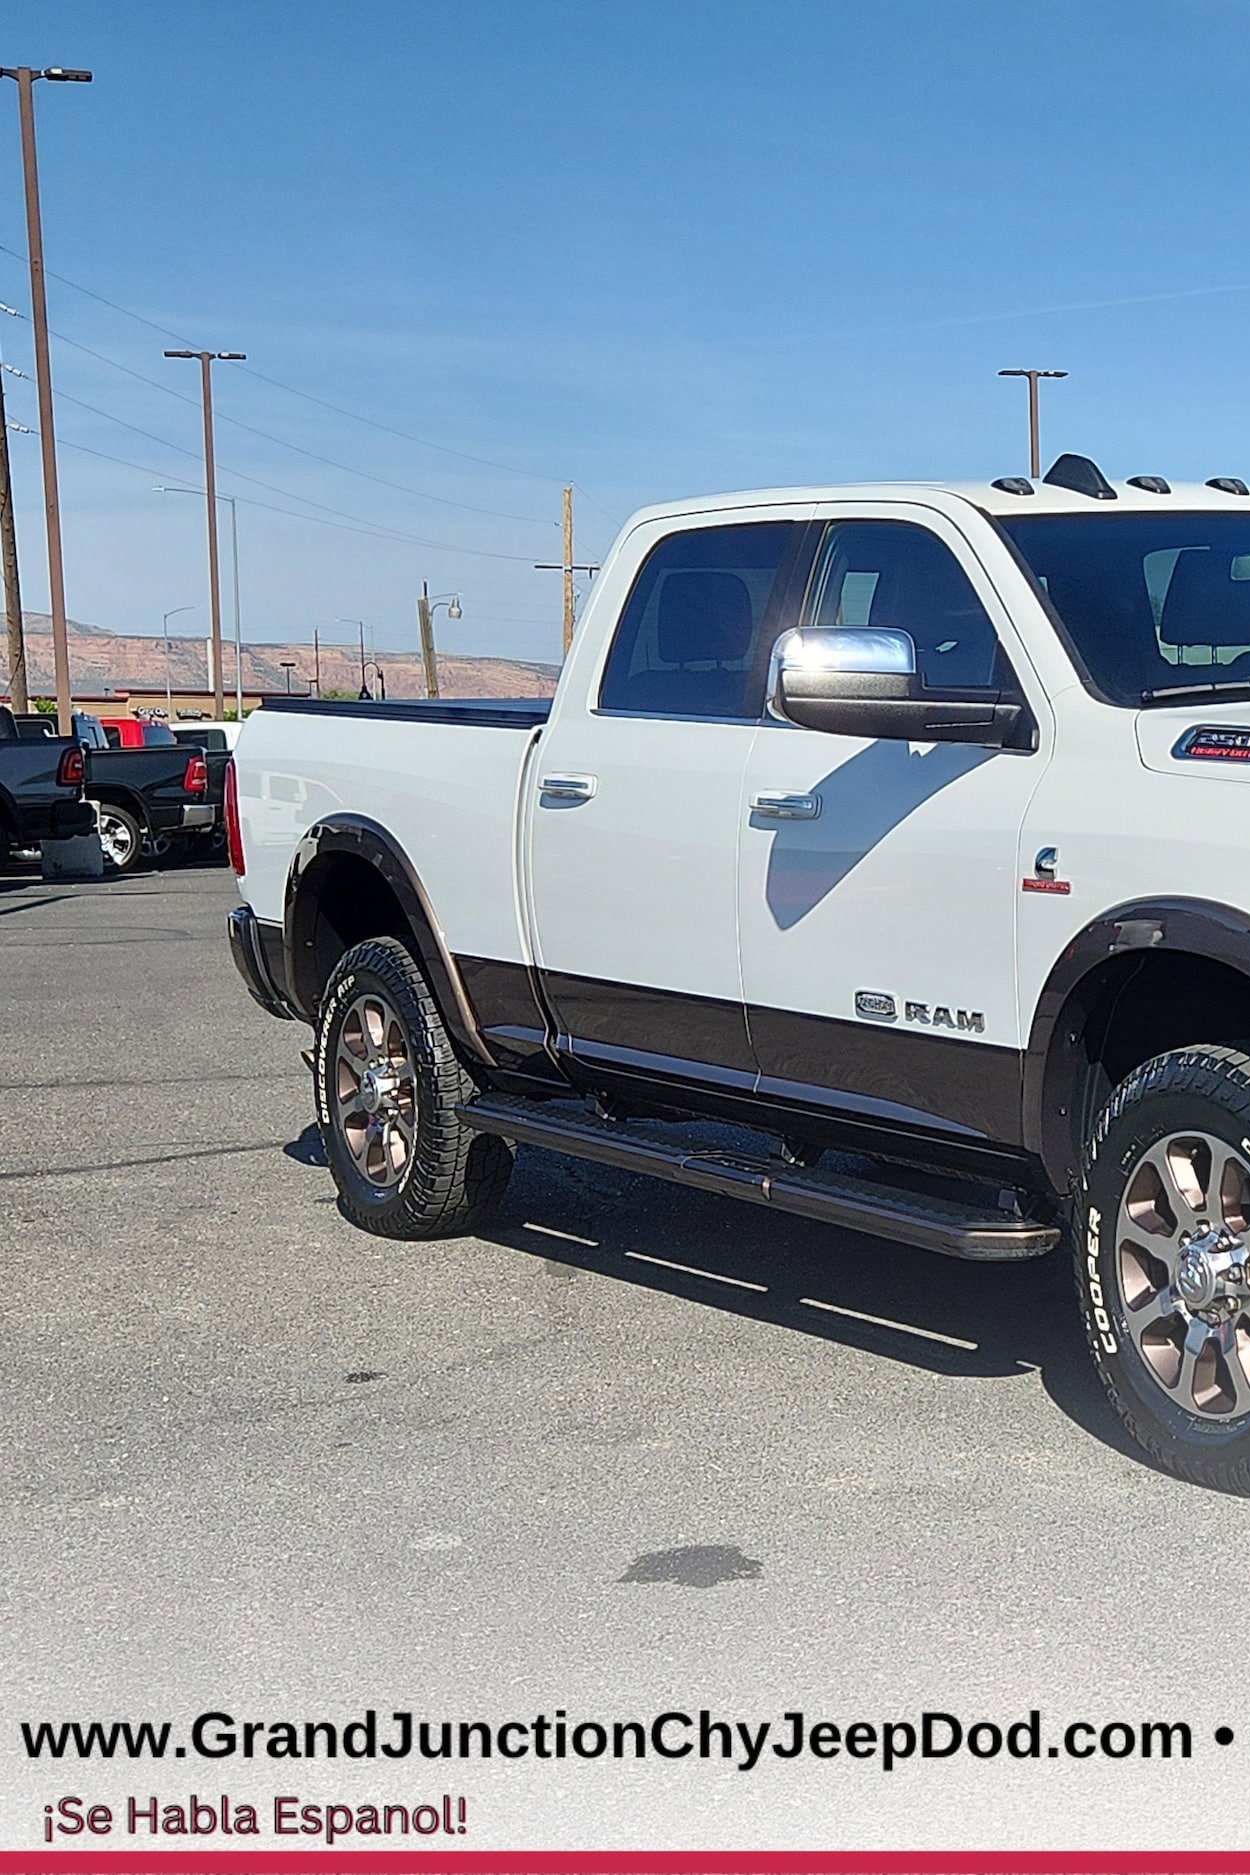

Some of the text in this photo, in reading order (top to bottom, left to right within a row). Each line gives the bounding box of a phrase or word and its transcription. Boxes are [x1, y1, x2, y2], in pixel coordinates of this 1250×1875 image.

[318, 974, 355, 1124] DISCOVERER ATP
[904, 1000, 985, 1033] RAM
[1087, 1206, 1118, 1354] COOPER
